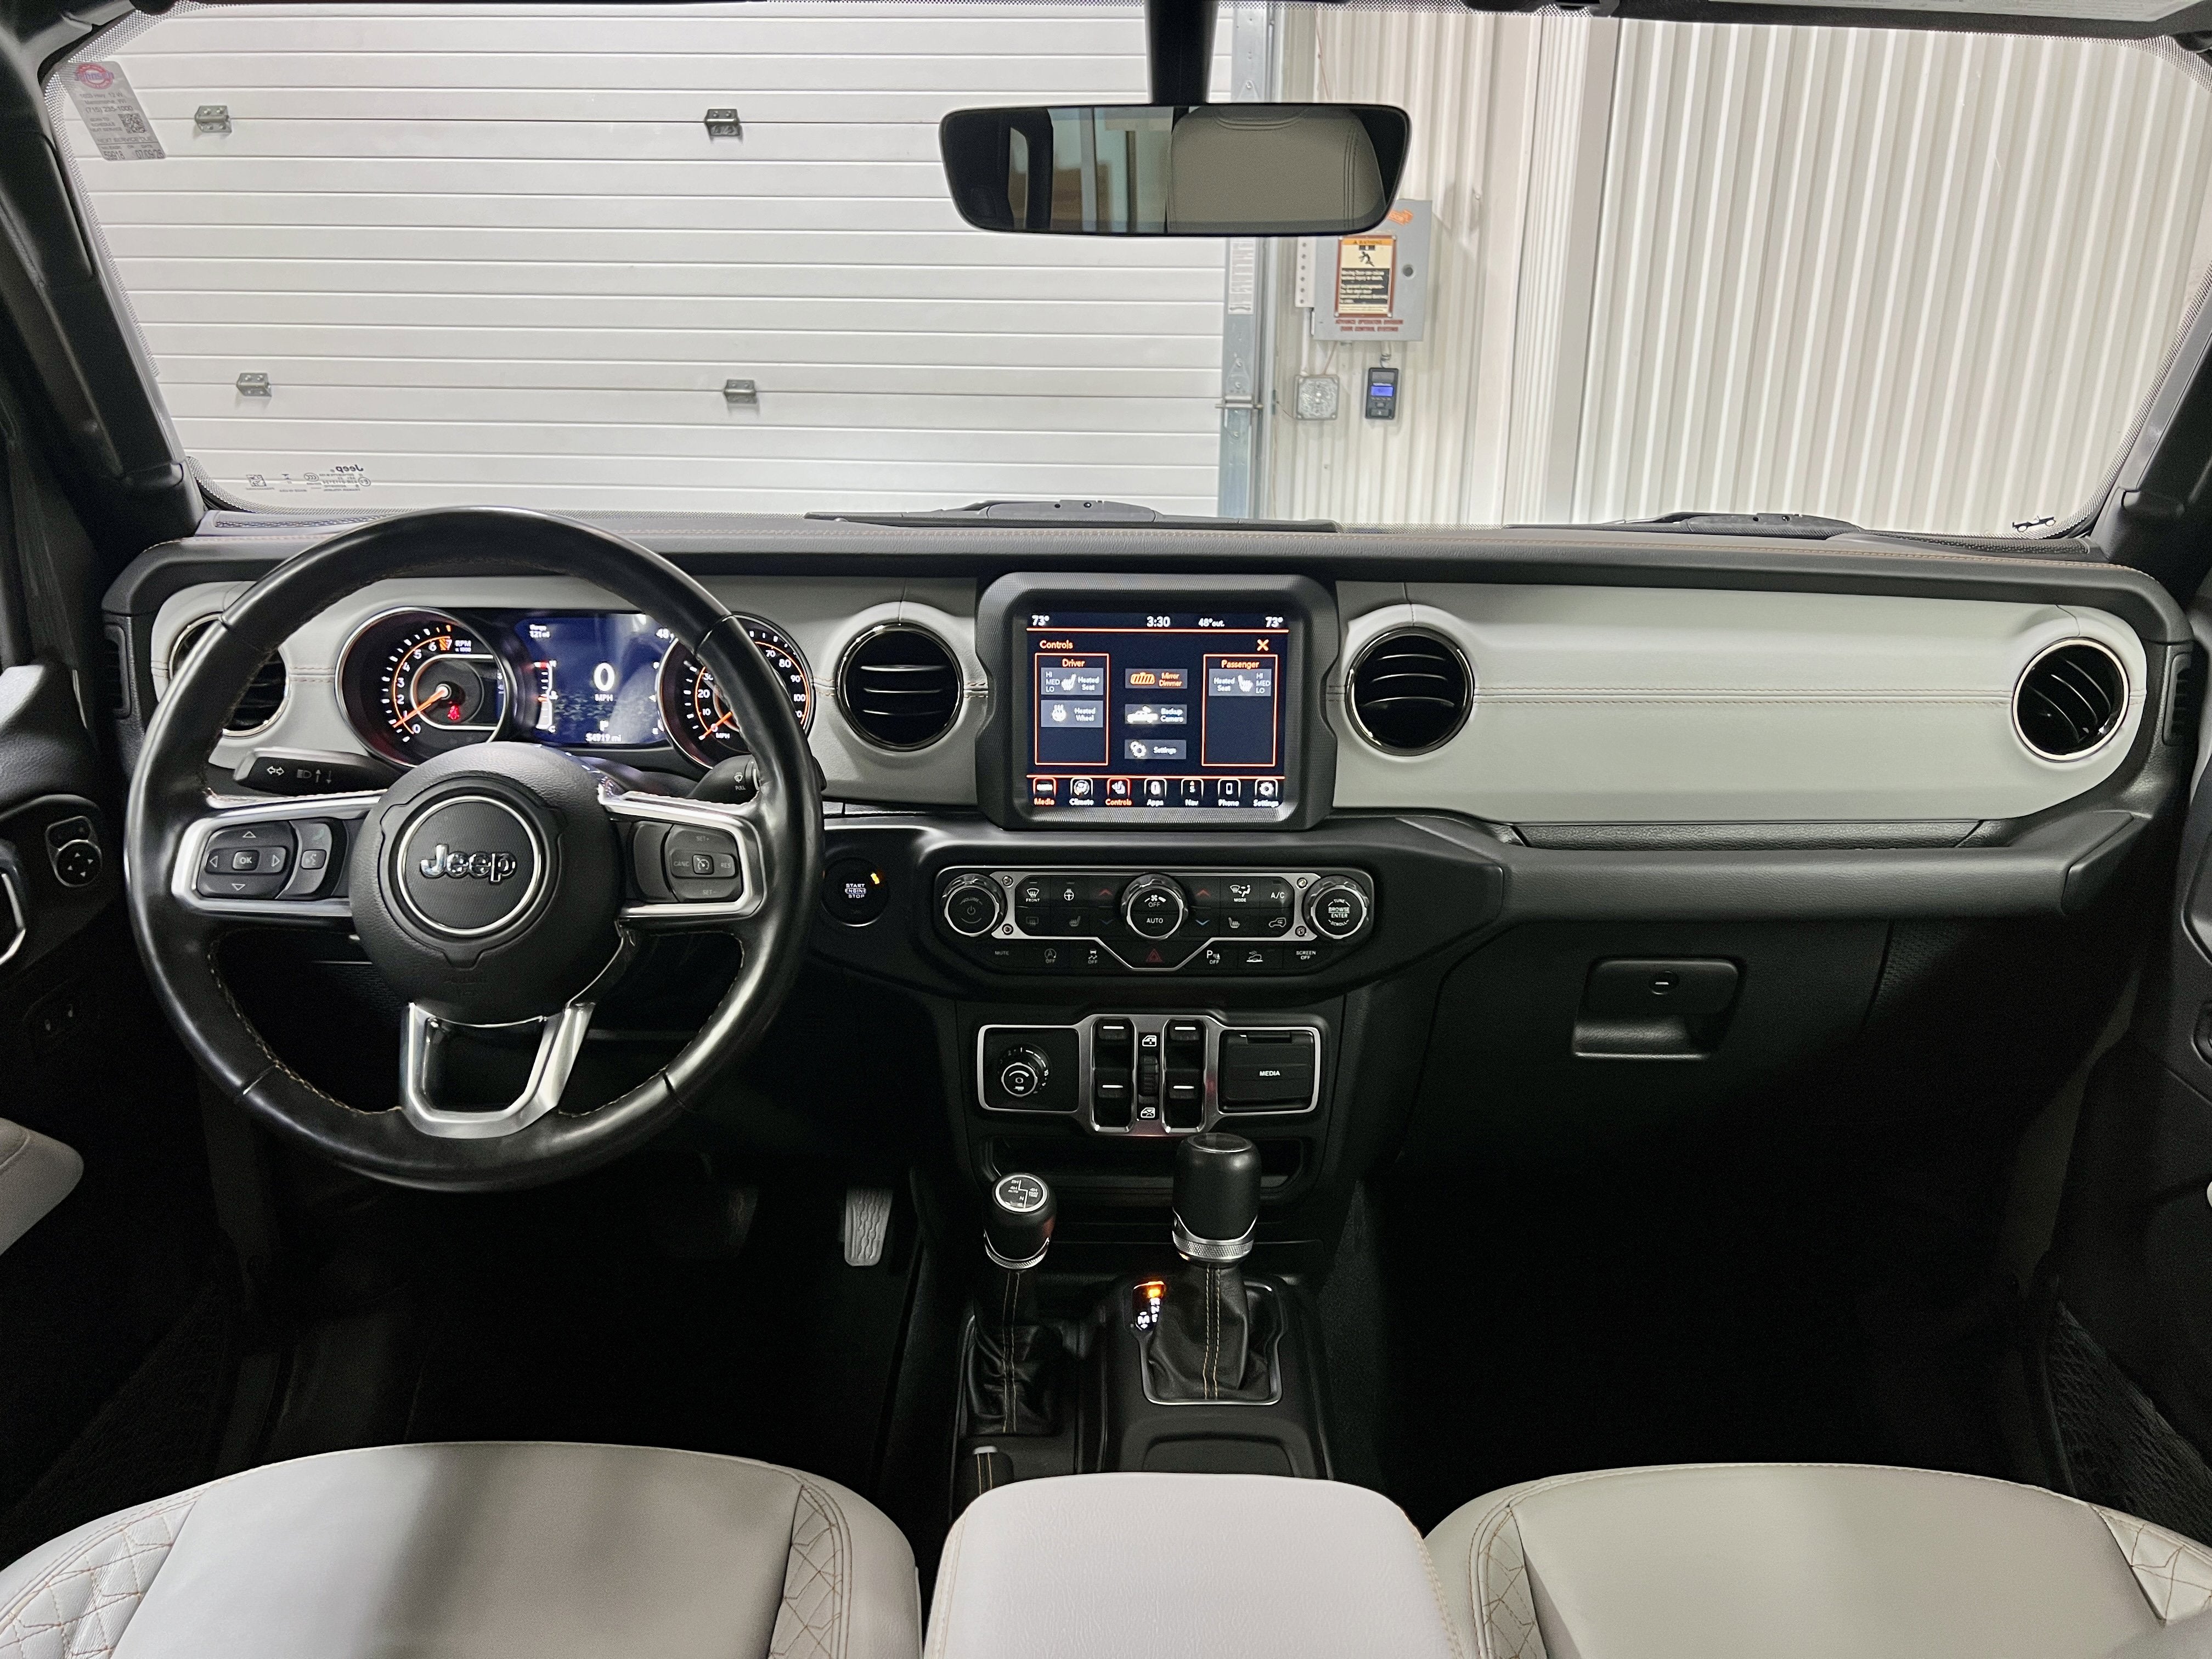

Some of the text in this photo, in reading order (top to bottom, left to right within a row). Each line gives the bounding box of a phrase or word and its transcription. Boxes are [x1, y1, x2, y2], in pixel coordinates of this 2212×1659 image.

[1147, 616, 1171, 627] 3:30
[428, 641, 437, 652] 6
[446, 639, 453, 650] 7
[1040, 640, 1073, 649] Controls
[413, 649, 422, 659] 5
[403, 662, 410, 672] 4
[778, 658, 792, 668] 80
[1062, 658, 1085, 667] Driver
[1221, 659, 1260, 669] Passenger
[594, 662, 615, 691] 0
[397, 678, 405, 687] 3
[697, 689, 710, 698] 20
[793, 693, 805, 702] 100
[397, 694, 405, 704] 2
[412, 724, 421, 733] 0
[1153, 746, 1177, 755] Settings
[1253, 799, 1279, 808] Settings
[420, 844, 518, 885] Jeep
